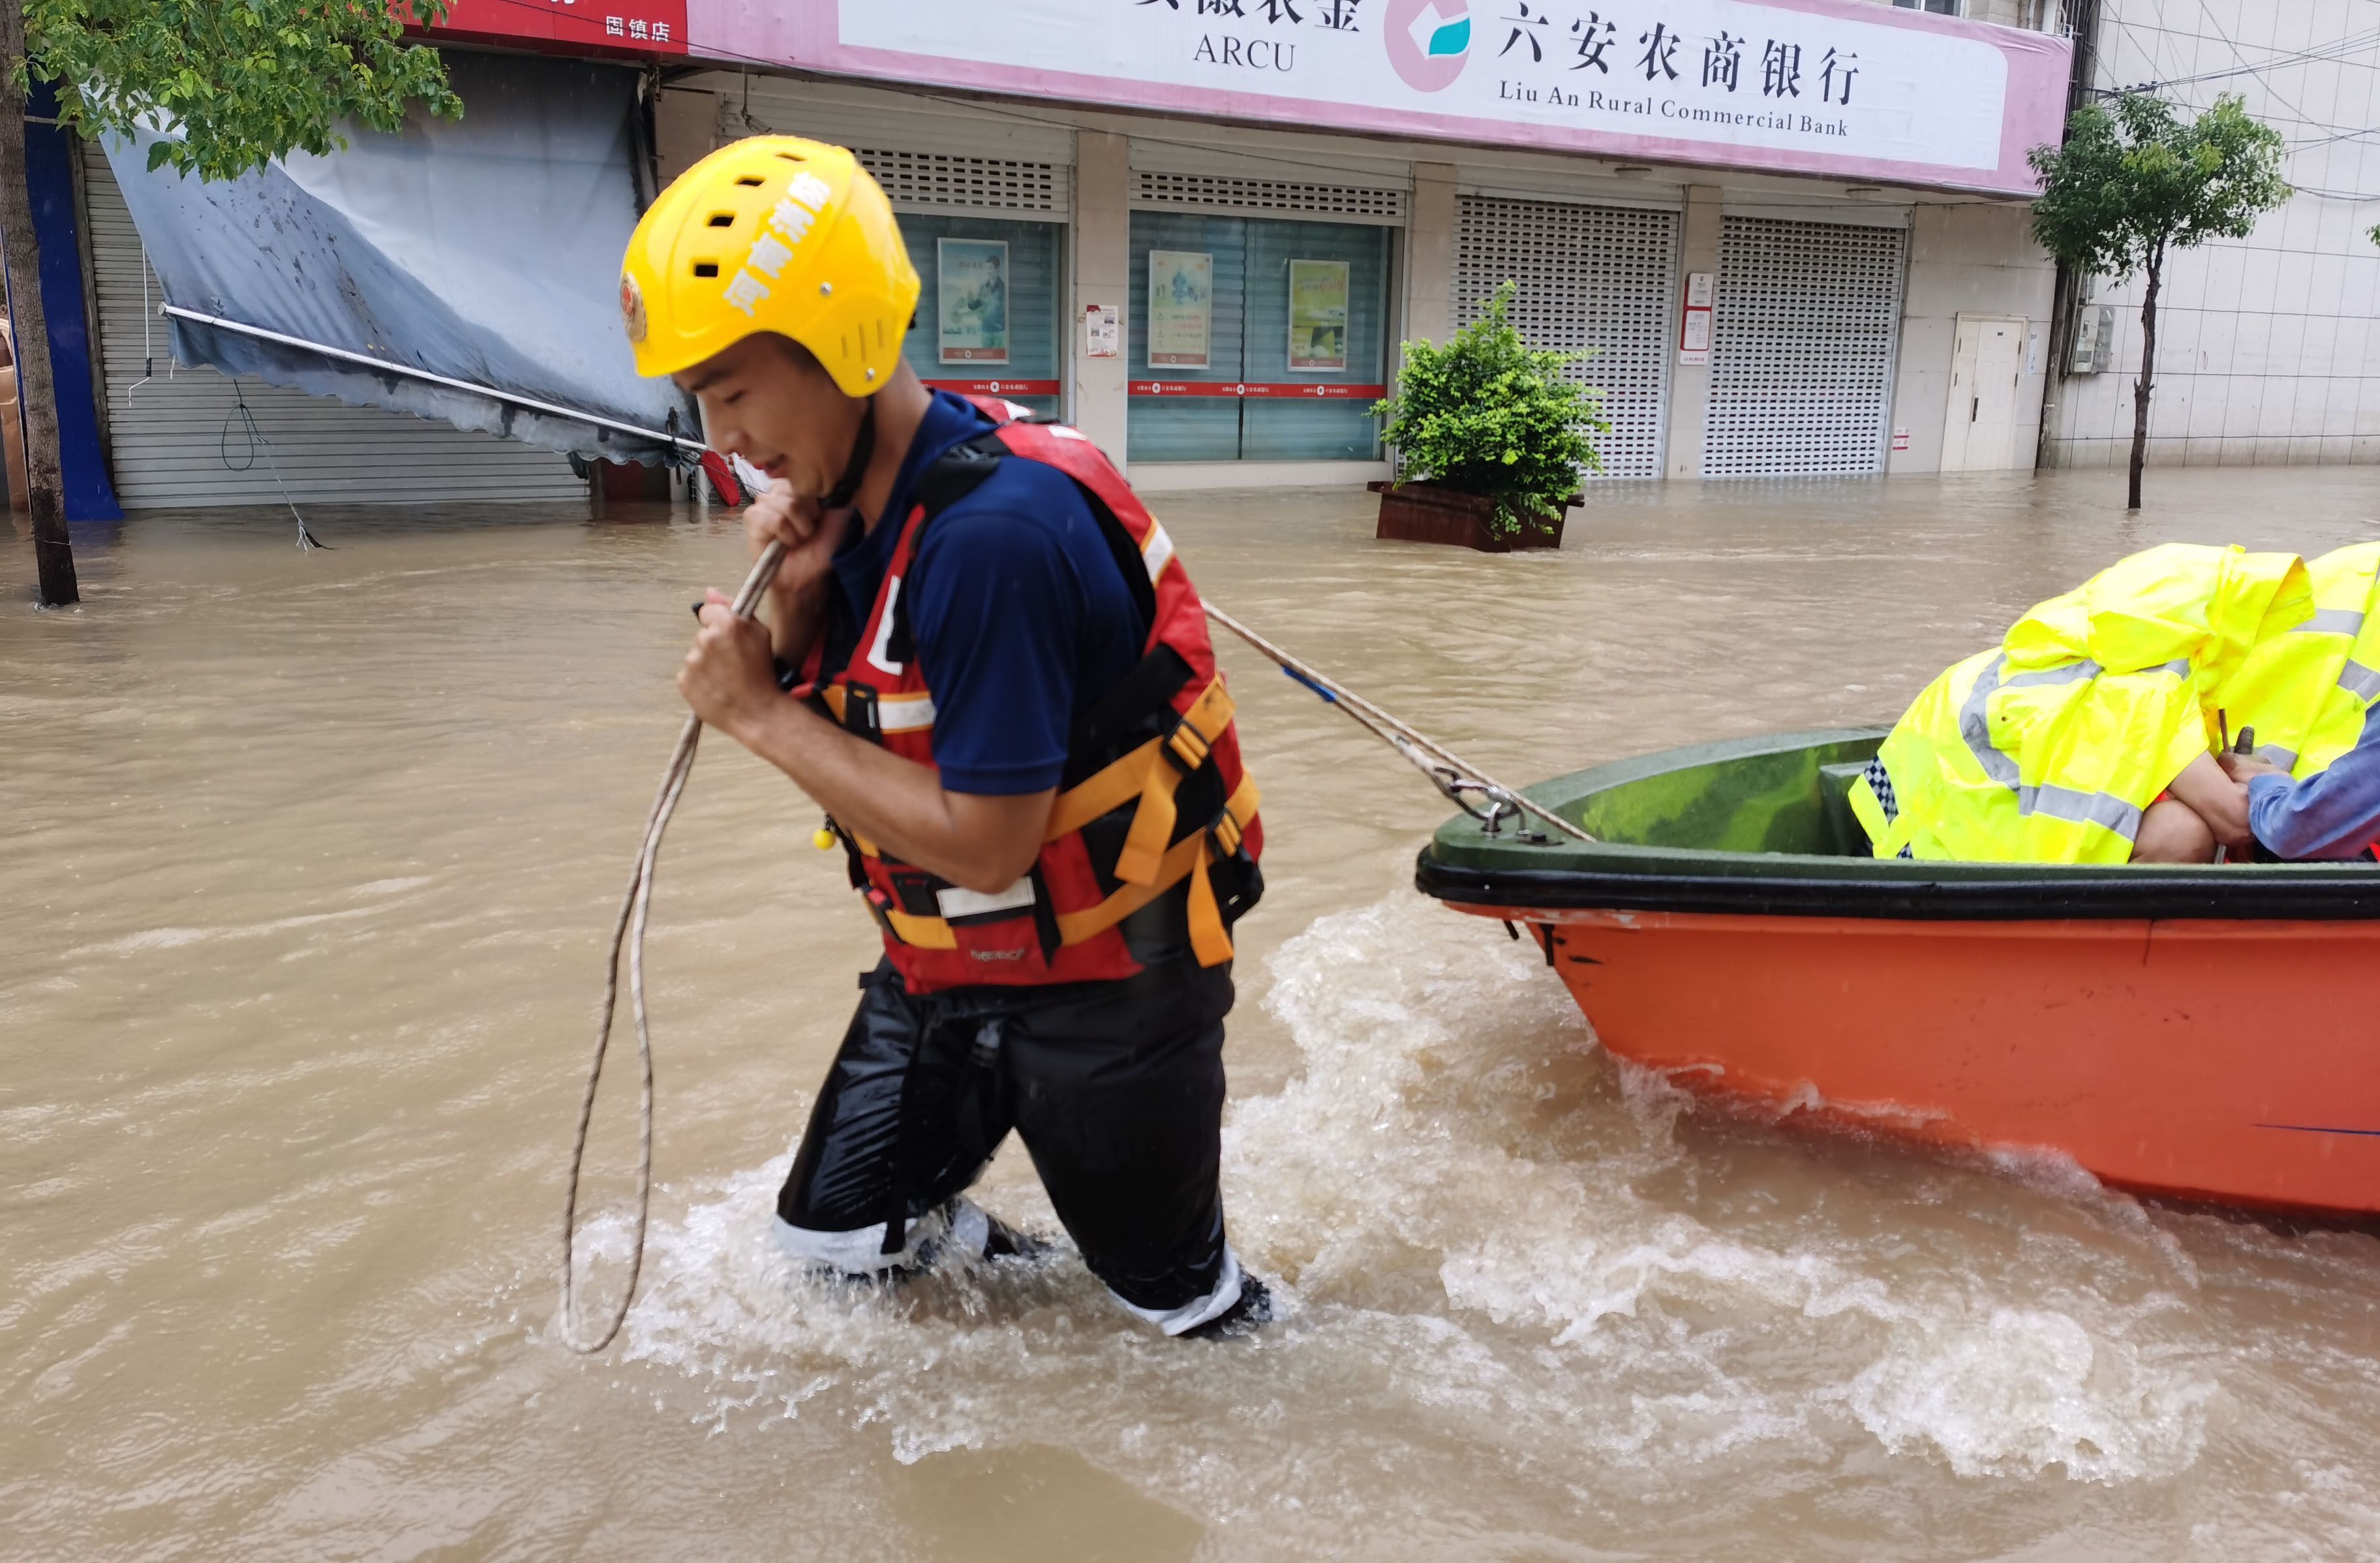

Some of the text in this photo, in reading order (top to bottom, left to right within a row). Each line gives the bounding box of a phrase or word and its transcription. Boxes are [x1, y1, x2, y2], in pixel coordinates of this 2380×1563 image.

[606, 16, 669, 42] 固镇店
[1193, 33, 1296, 72] ARCU
[1498, 1, 1860, 106] 六安农商银行
[1499, 80, 1848, 136] Liu An Rural Commercial Bank
